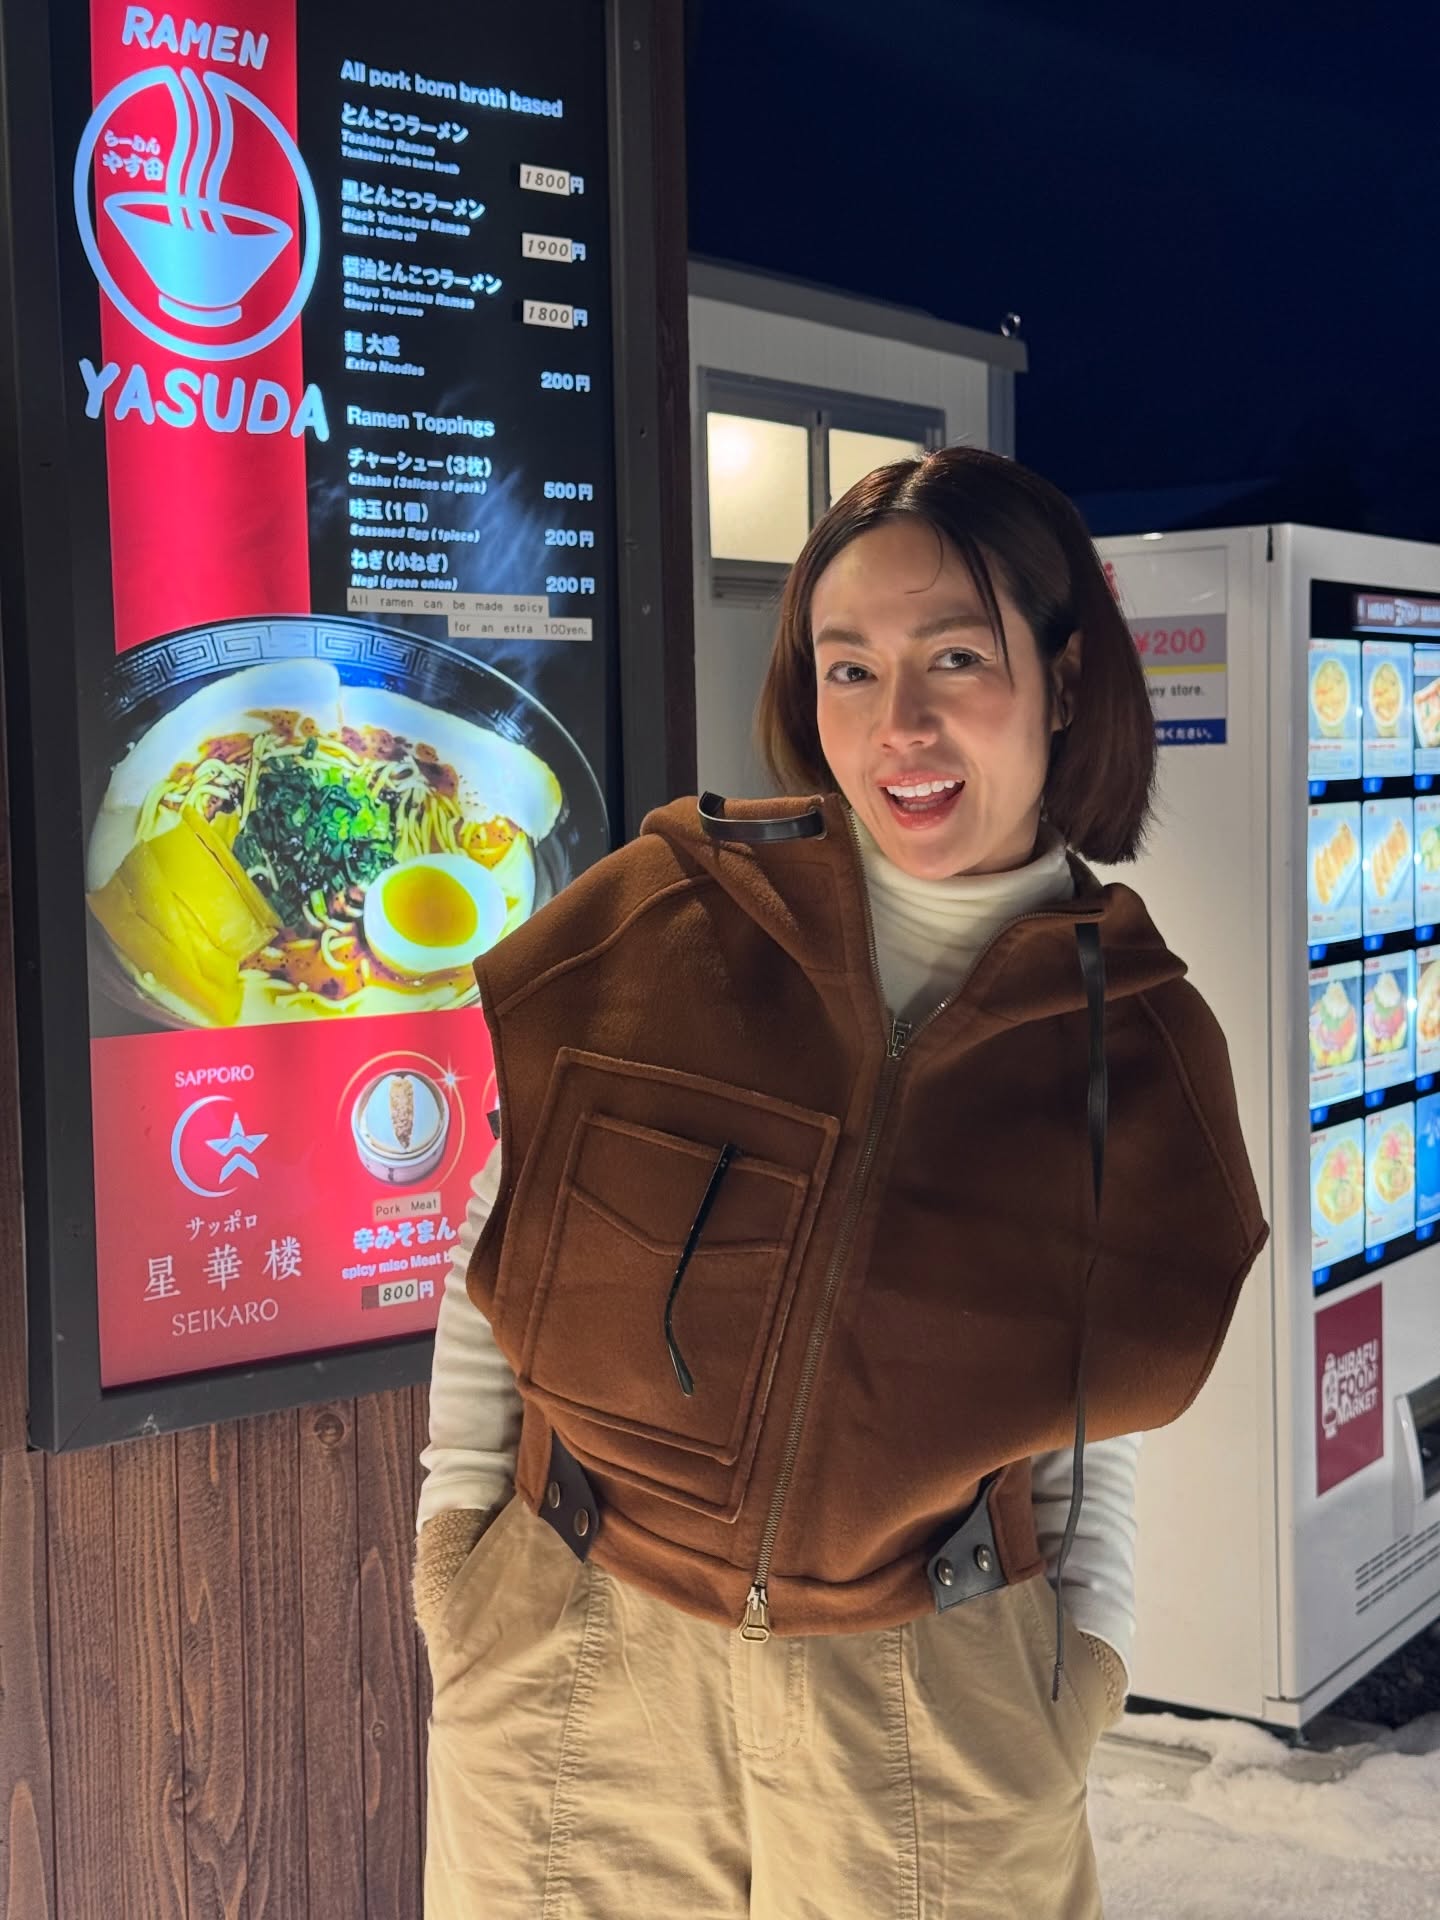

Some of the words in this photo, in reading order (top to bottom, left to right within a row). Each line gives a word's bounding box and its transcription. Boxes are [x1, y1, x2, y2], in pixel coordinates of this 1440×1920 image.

[122, 5, 270, 71] RAMEN
[340, 58, 366, 83] All
[368, 66, 412, 92] pork
[459, 81, 508, 109] broth
[509, 90, 564, 118] based
[341, 102, 469, 144] とんこつラーメン
[104, 129, 161, 155] らーめん
[102, 150, 165, 181] やす田
[523, 170, 585, 195] 1800円
[341, 178, 486, 220] 黒とんこつラーメン
[527, 239, 586, 261] 1900円
[342, 254, 503, 295] 醤油とんこつラーメン
[343, 281, 380, 299] Shoyu
[527, 305, 588, 328] 1800円
[345, 355, 377, 372] Extra
[378, 359, 426, 377] Noodles
[540, 371, 591, 393] 200円
[78, 357, 331, 443] YASUDA
[346, 405, 410, 430] Ramen
[411, 411, 496, 439] Toppings
[348, 472, 392, 488] Chashu
[441, 479, 455, 493] of
[455, 480, 488, 496] pork)
[543, 481, 593, 502] 500円
[350, 523, 406, 539] Seasoned
[407, 527, 430, 542] Egg
[544, 528, 595, 549] 200円
[351, 573, 379, 590] Negi
[380, 575, 418, 590] (green
[420, 577, 459, 591] onion)
[545, 576, 595, 595] 200円
[350, 592, 370, 607] All
[380, 596, 414, 608] ramen
[423, 598, 443, 610] can
[452, 595, 466, 611] be
[475, 596, 503, 612] made
[513, 599, 544, 617] spicy
[453, 620, 471, 633] for
[481, 623, 494, 634] an
[503, 621, 533, 635] extra
[544, 618, 588, 638] 100yen.
[1135, 627, 1206, 656] ¥200
[1170, 682, 1206, 697] store.
[174, 1064, 255, 1089] SAPPORO
[375, 1204, 402, 1217] Pork
[410, 1198, 438, 1212] Meat
[185, 1209, 258, 1241] サッポロ
[353, 1216, 457, 1254] 辛みそまん
[342, 1264, 377, 1280] spicy
[378, 1259, 409, 1273] miso
[410, 1253, 442, 1269] Meat
[382, 1280, 435, 1302] 800円
[171, 1297, 280, 1337] SEIKARO
